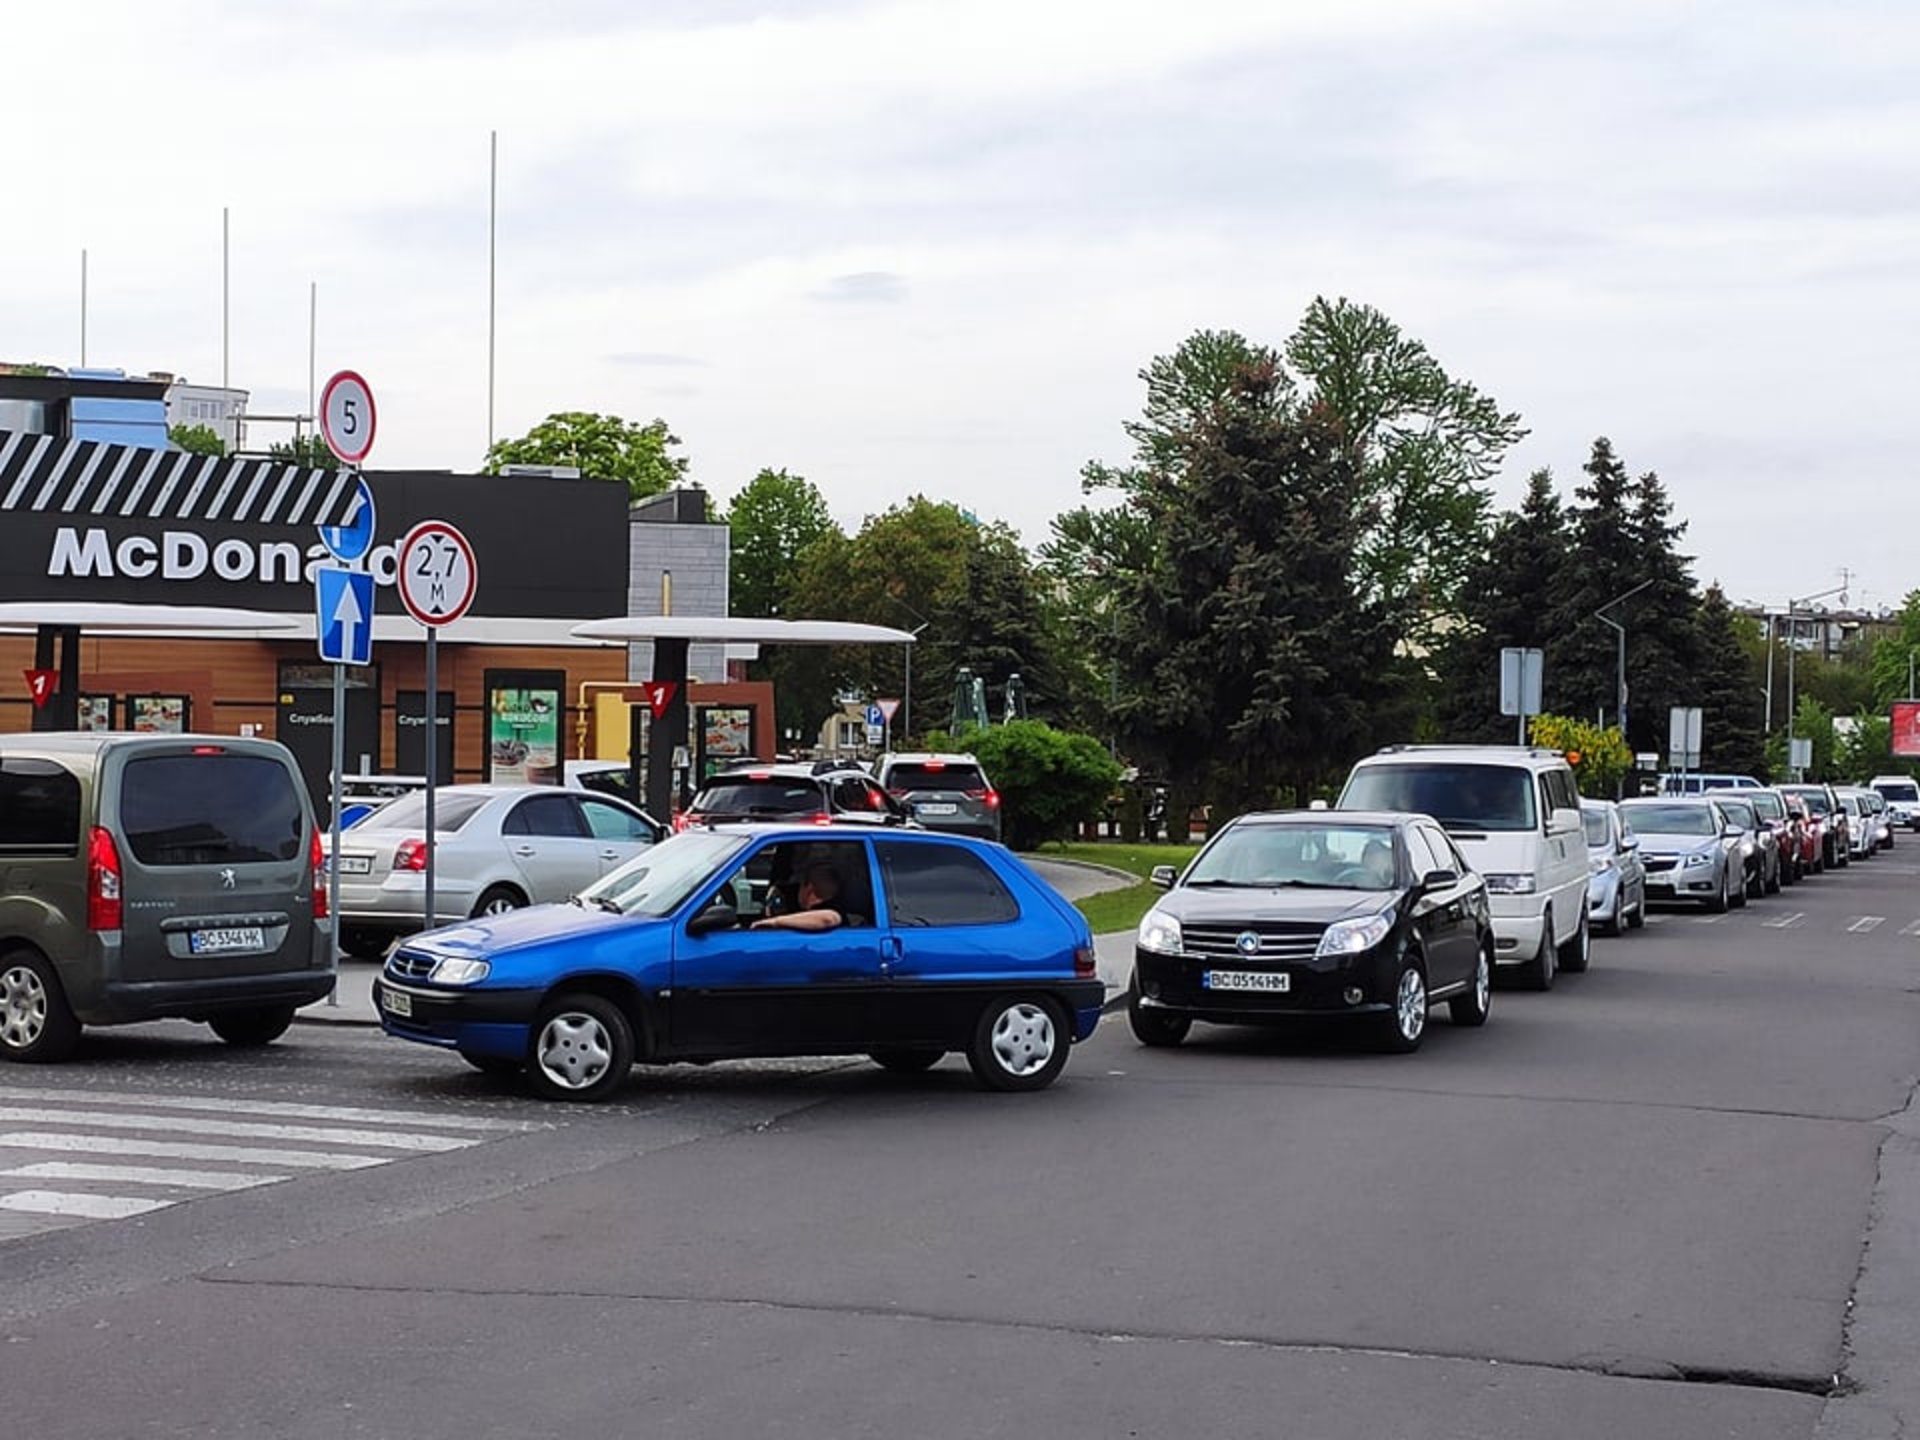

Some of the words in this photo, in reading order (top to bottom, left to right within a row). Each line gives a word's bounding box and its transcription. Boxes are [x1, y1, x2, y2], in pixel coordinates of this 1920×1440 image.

[343, 399, 357, 435] 5
[417, 544, 458, 581] 2,7
[33, 674, 46, 695] 1
[653, 687, 665, 705] 1
[871, 706, 881, 723] P
